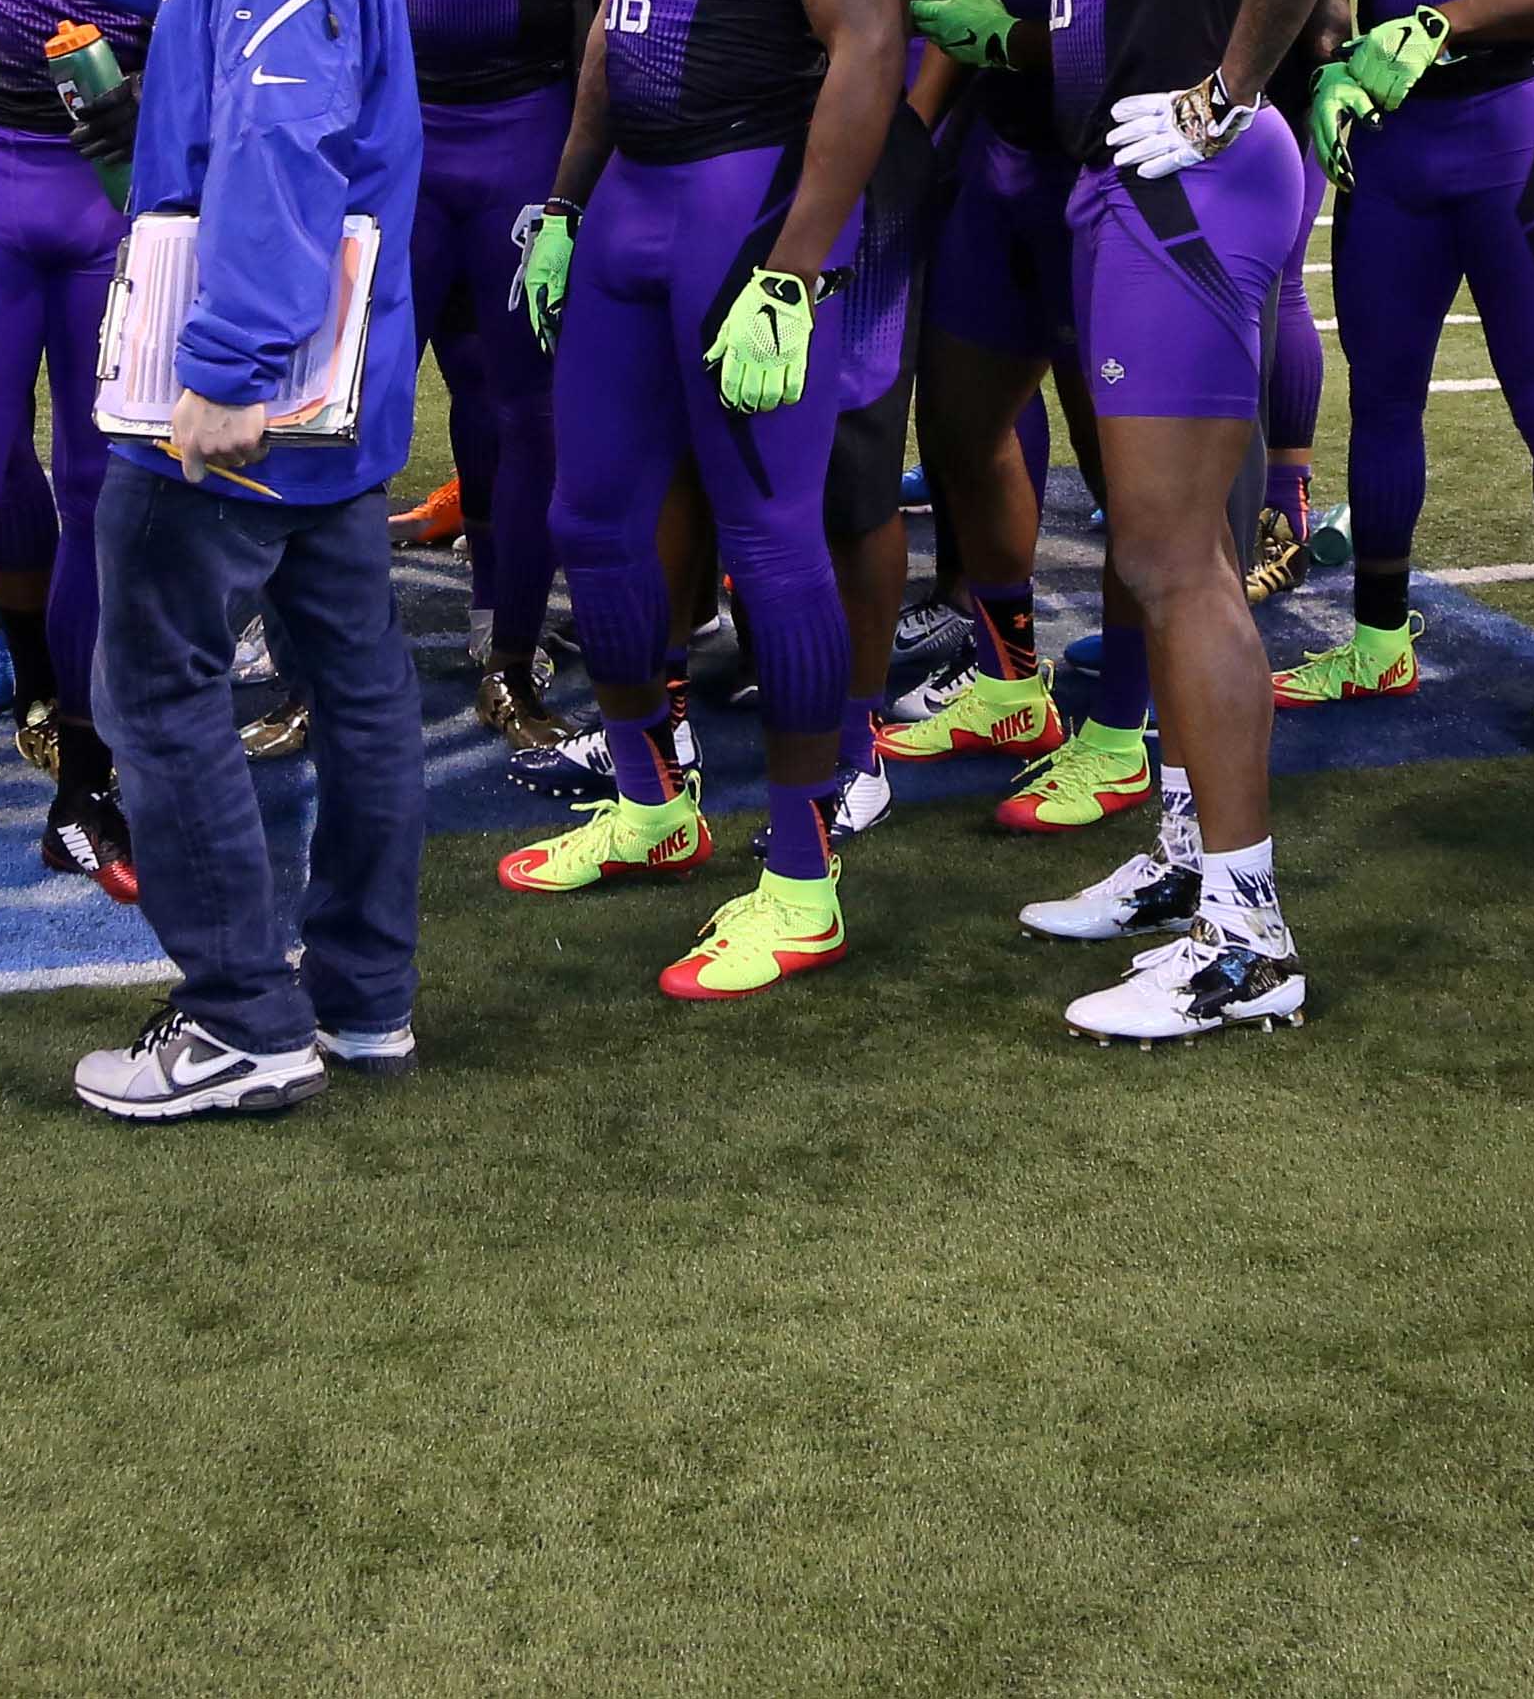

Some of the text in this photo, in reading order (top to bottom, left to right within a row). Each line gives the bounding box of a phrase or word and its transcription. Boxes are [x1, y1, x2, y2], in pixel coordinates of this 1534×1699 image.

[1378, 652, 1408, 691] NIKE
[990, 705, 1035, 745] NIKE
[57, 822, 100, 871] NIKE
[647, 823, 690, 868] NIKE
